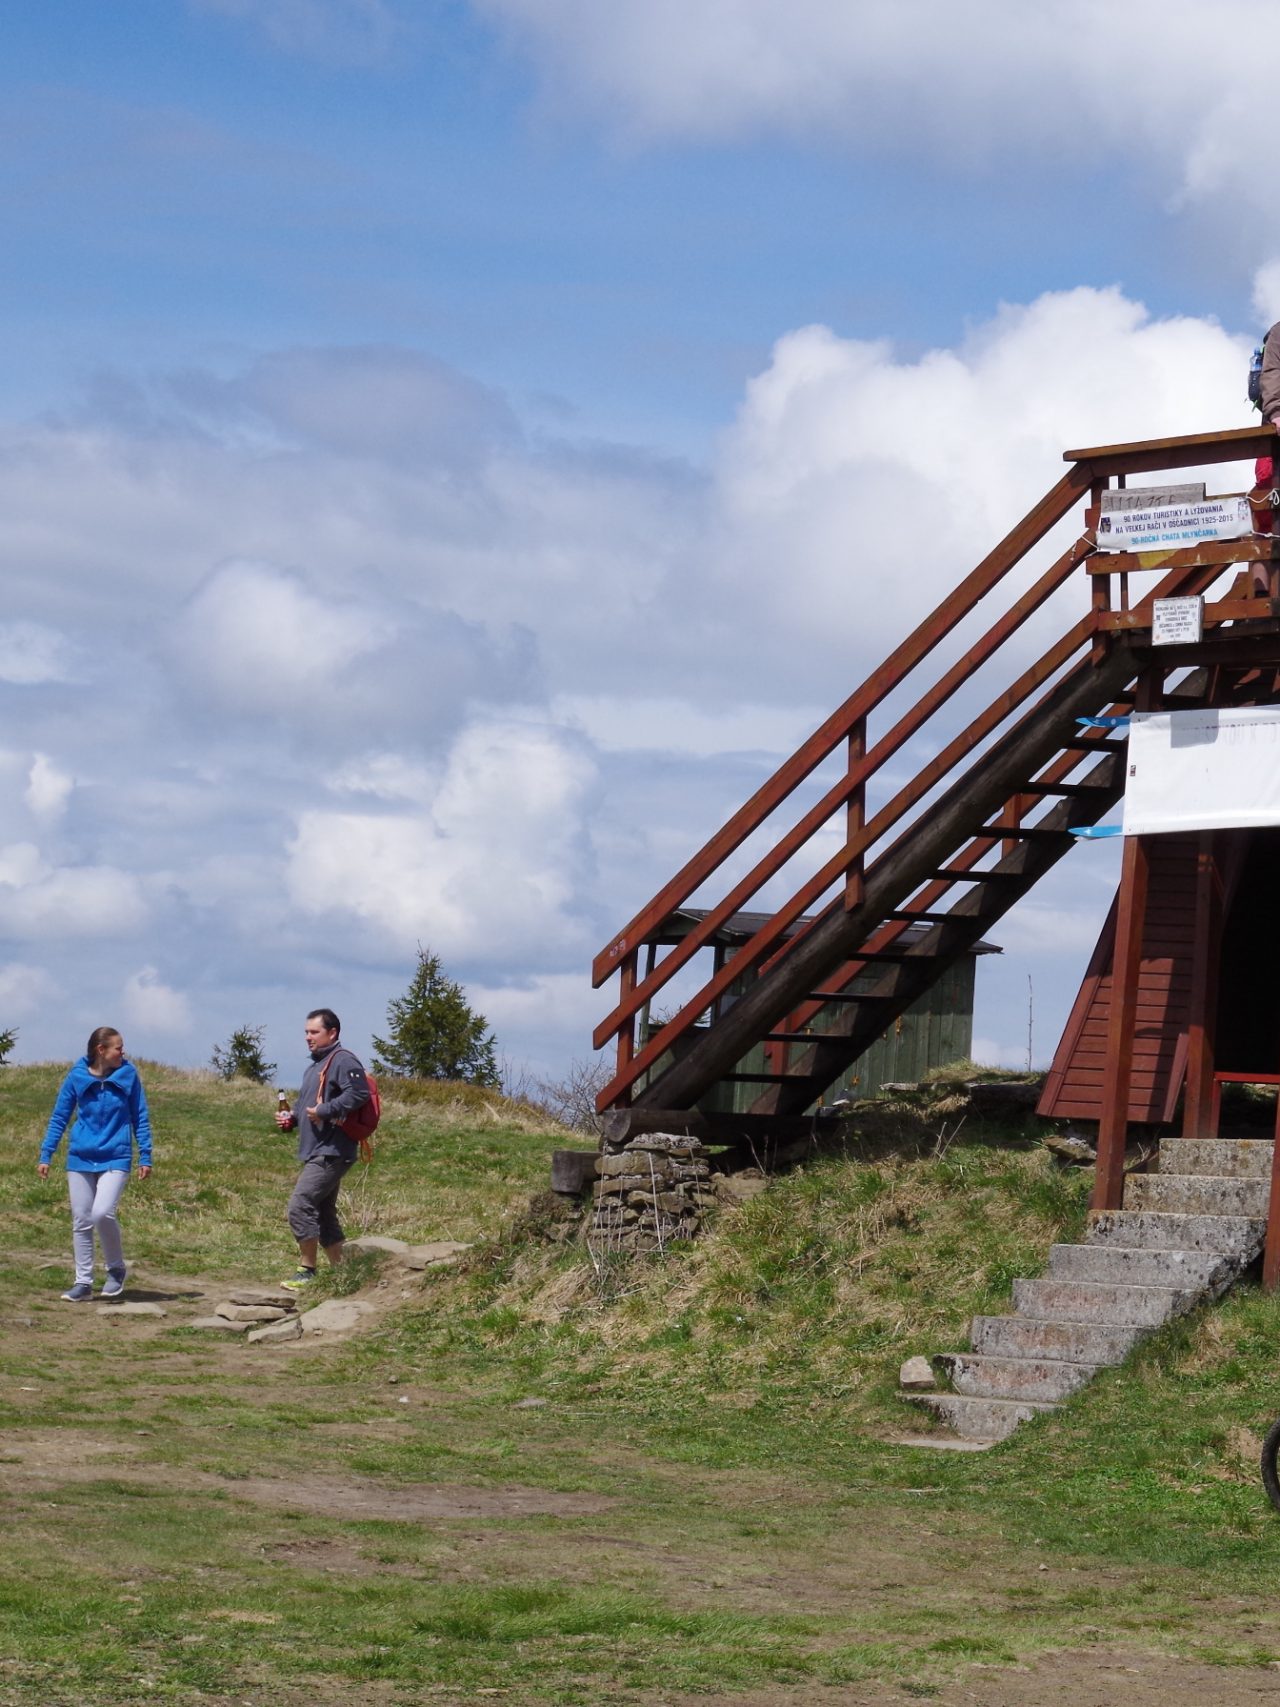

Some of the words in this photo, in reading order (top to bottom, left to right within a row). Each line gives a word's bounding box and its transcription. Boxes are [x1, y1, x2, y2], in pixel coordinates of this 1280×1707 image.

[1132, 513, 1151, 522] ROKOV
[1153, 509, 1182, 520] TURISTIKY
[1185, 508, 1189, 516] A
[1190, 504, 1223, 515] LYŽOVANIA
[1116, 525, 1124, 534] NA
[1202, 514, 1234, 525] 1925-2015
[1162, 532, 1180, 541] CHATA
